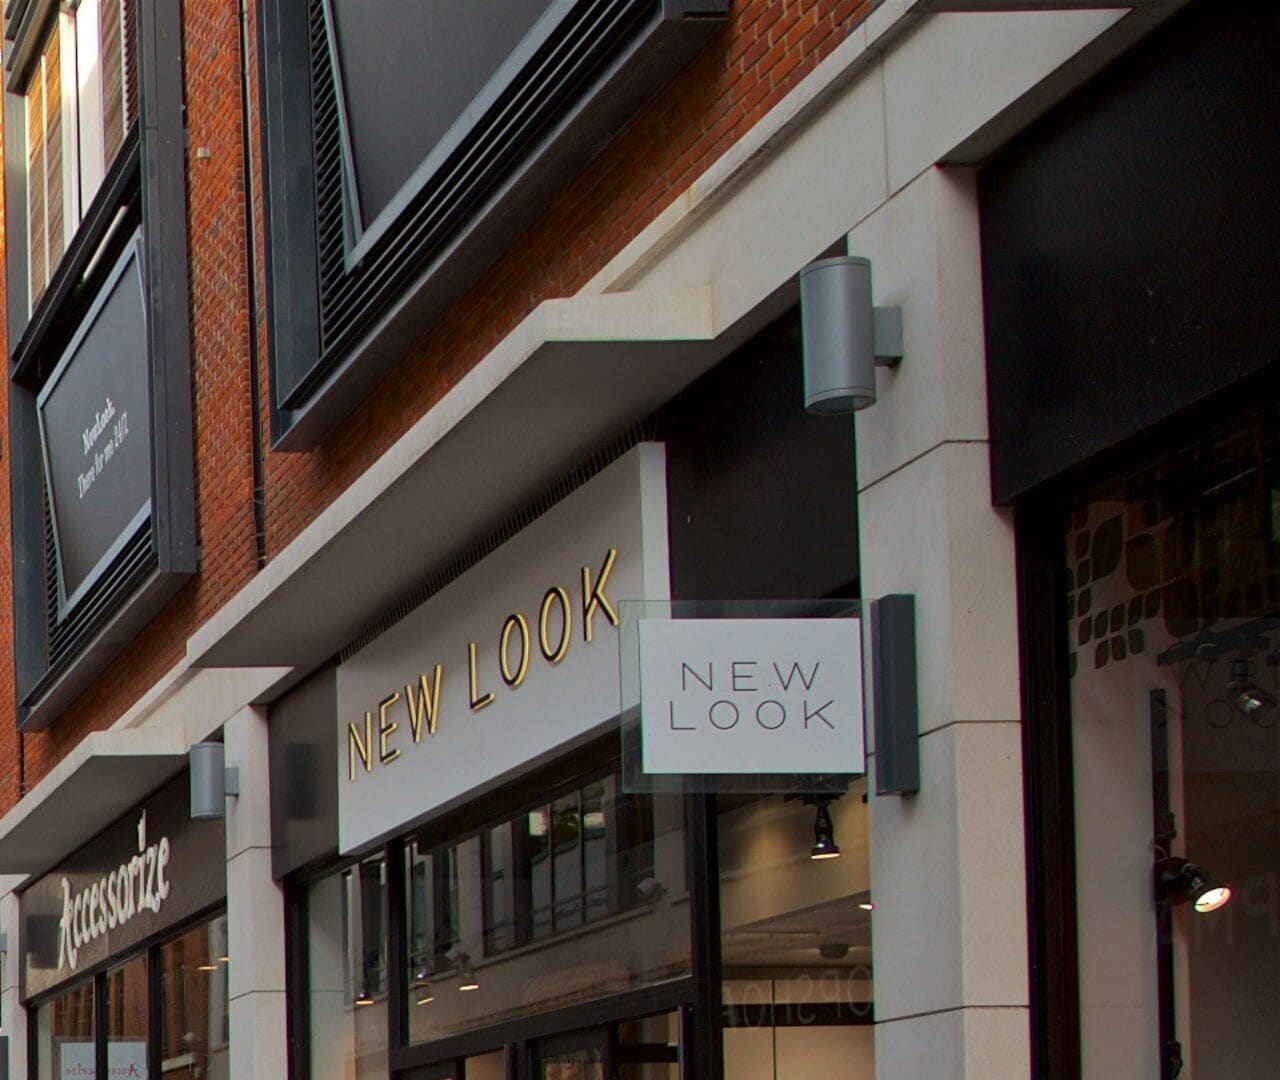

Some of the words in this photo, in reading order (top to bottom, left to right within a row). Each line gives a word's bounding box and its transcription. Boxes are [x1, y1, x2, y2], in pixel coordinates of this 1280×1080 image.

[348, 664, 443, 782] NEW
[469, 548, 620, 712] LOOK
[681, 661, 820, 691] NEW
[670, 700, 835, 730] LOOK
[57, 808, 171, 971] Accessorize
